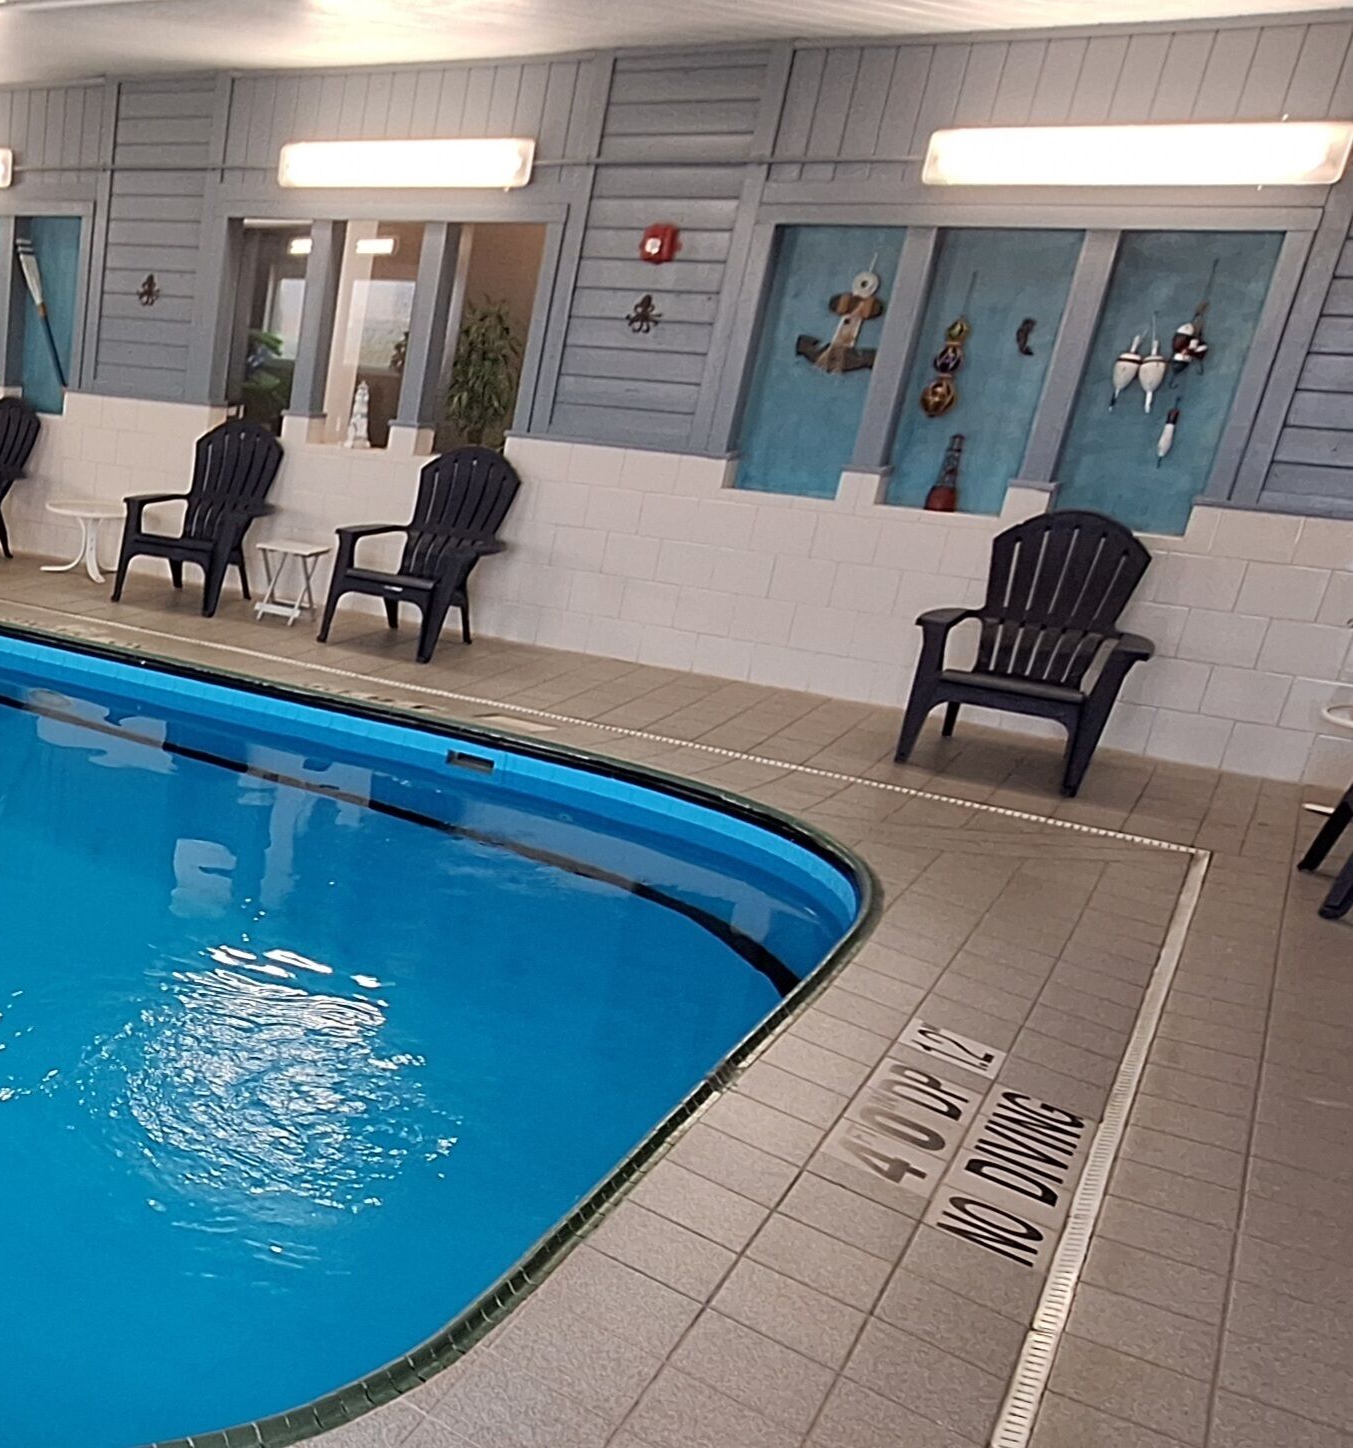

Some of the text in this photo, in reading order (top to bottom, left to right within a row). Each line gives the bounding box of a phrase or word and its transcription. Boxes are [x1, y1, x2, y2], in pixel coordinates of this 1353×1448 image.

[879, 1064, 970, 1122] DP
[839, 1134, 928, 1185] 4
[935, 1091, 1086, 1268] NO DIVING
